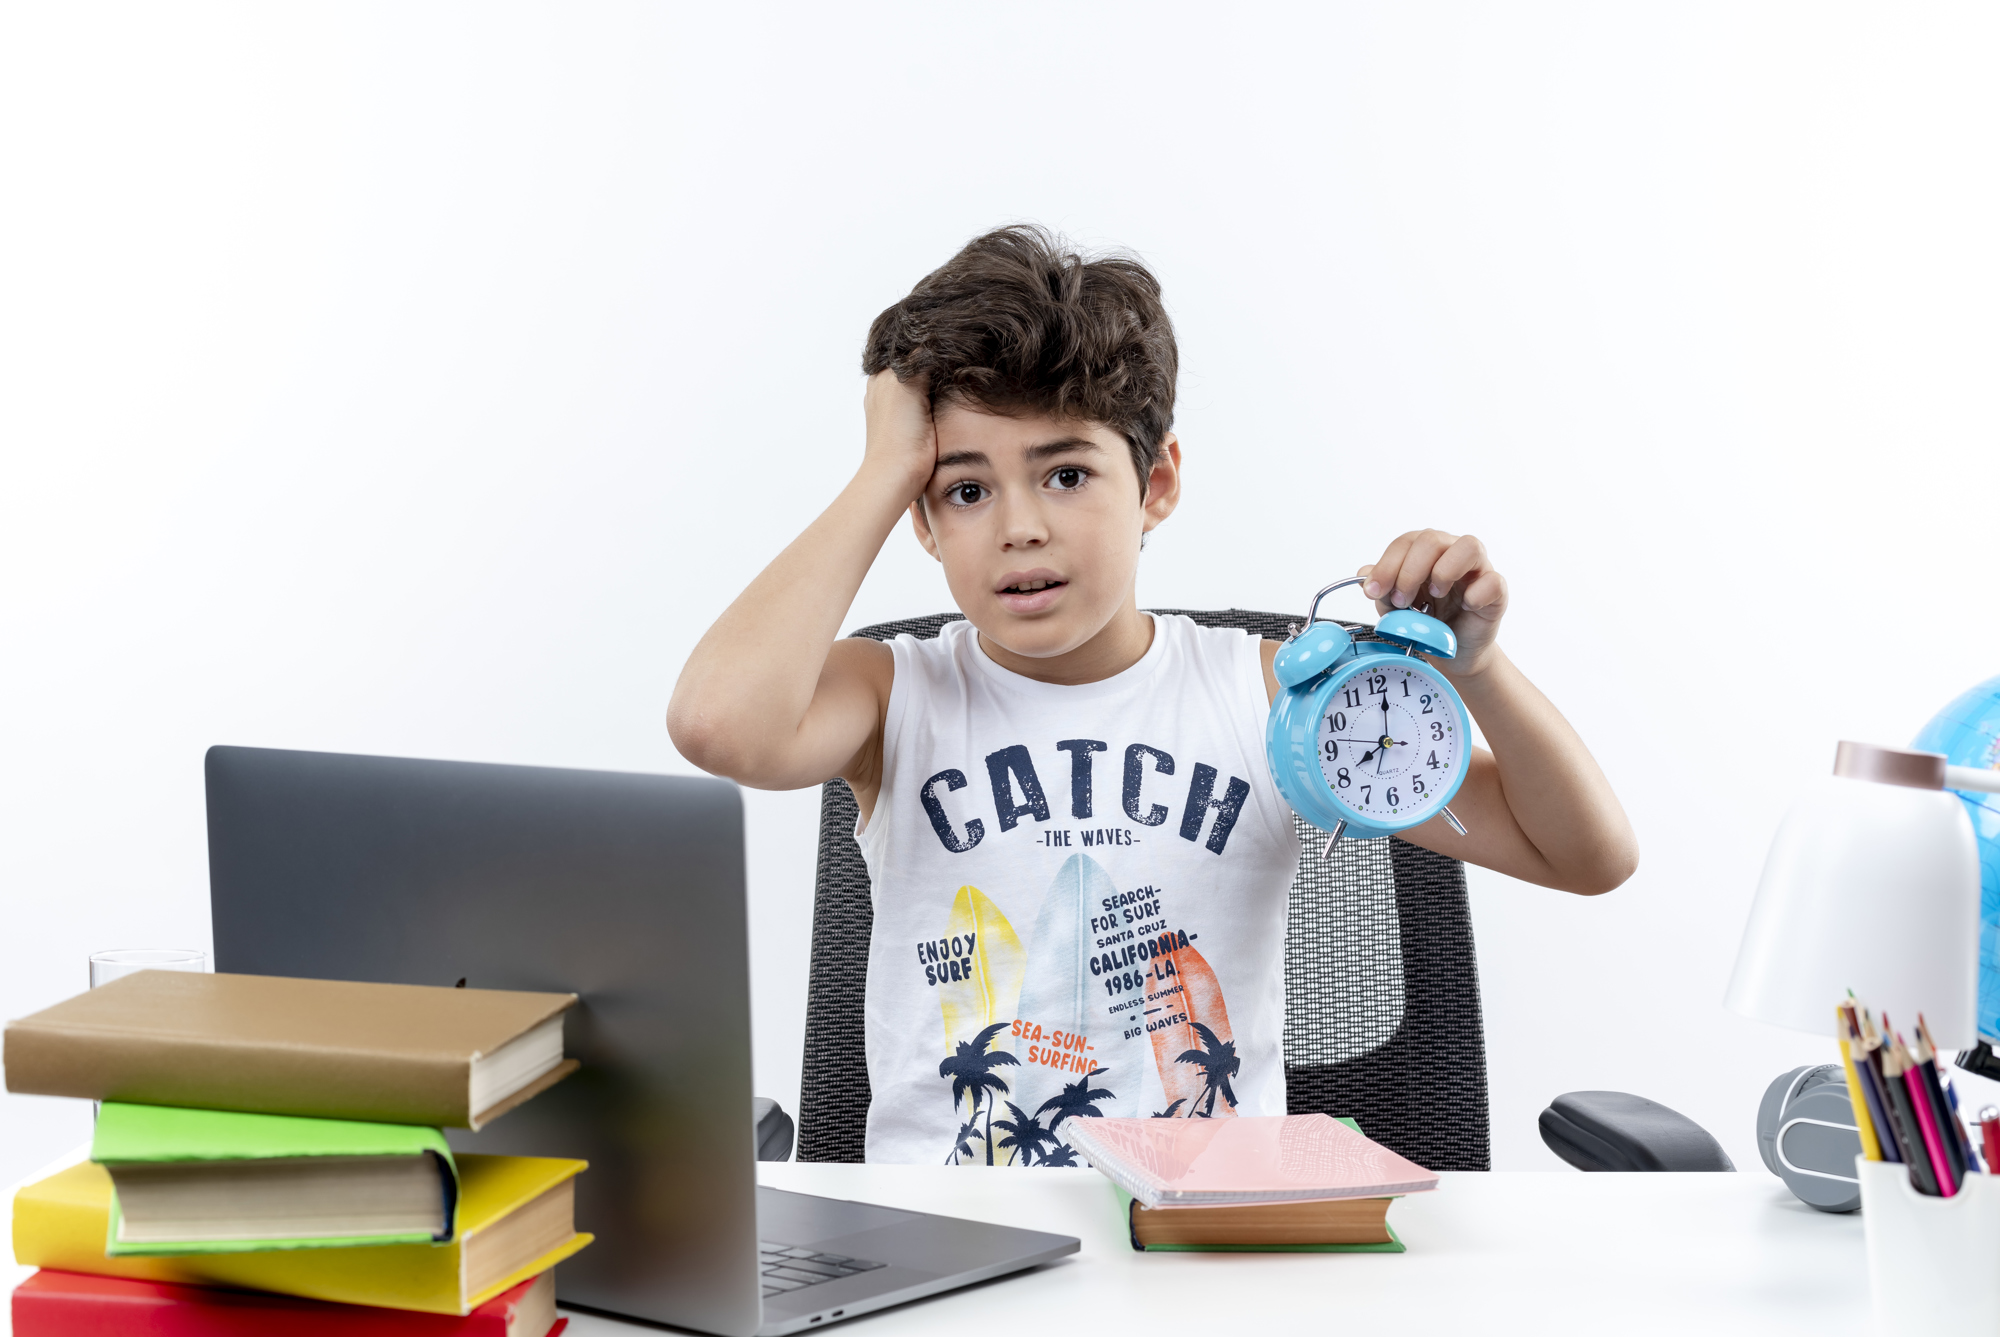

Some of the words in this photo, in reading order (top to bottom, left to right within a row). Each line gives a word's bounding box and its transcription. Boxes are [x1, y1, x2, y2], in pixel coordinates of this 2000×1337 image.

[1366, 674, 1388, 696] 12
[1400, 678, 1412, 698] 1
[1343, 687, 1363, 709] 11
[1419, 694, 1433, 715] 2
[1326, 711, 1347, 734] 10
[1430, 721, 1445, 742] 3
[1324, 739, 1339, 762] 9
[1426, 749, 1441, 771] 4
[1337, 767, 1352, 789] 8
[1379, 767, 1400, 776] QUARTZ
[1360, 784, 1372, 805] 7
[1412, 773, 1426, 794] 5
[920, 739, 1251, 856] CATCH
[1386, 786, 1400, 807] 6
[1102, 885, 1162, 912] SEARCH-
[1091, 913, 1119, 934] FOR
[1123, 899, 1161, 924] SURF
[1096, 930, 1135, 949] SANTA
[1137, 919, 1168, 936] CRUZ
[917, 932, 976, 965] ENJOY
[925, 957, 972, 986] SURF
[1108, 997, 1145, 1015] ENDLESS
[1147, 984, 1185, 1002] SUMMER
[1123, 1026, 1142, 1040] BIG
[1145, 1012, 1188, 1033] WAVES
[1028, 1045, 1098, 1077] SURFING
